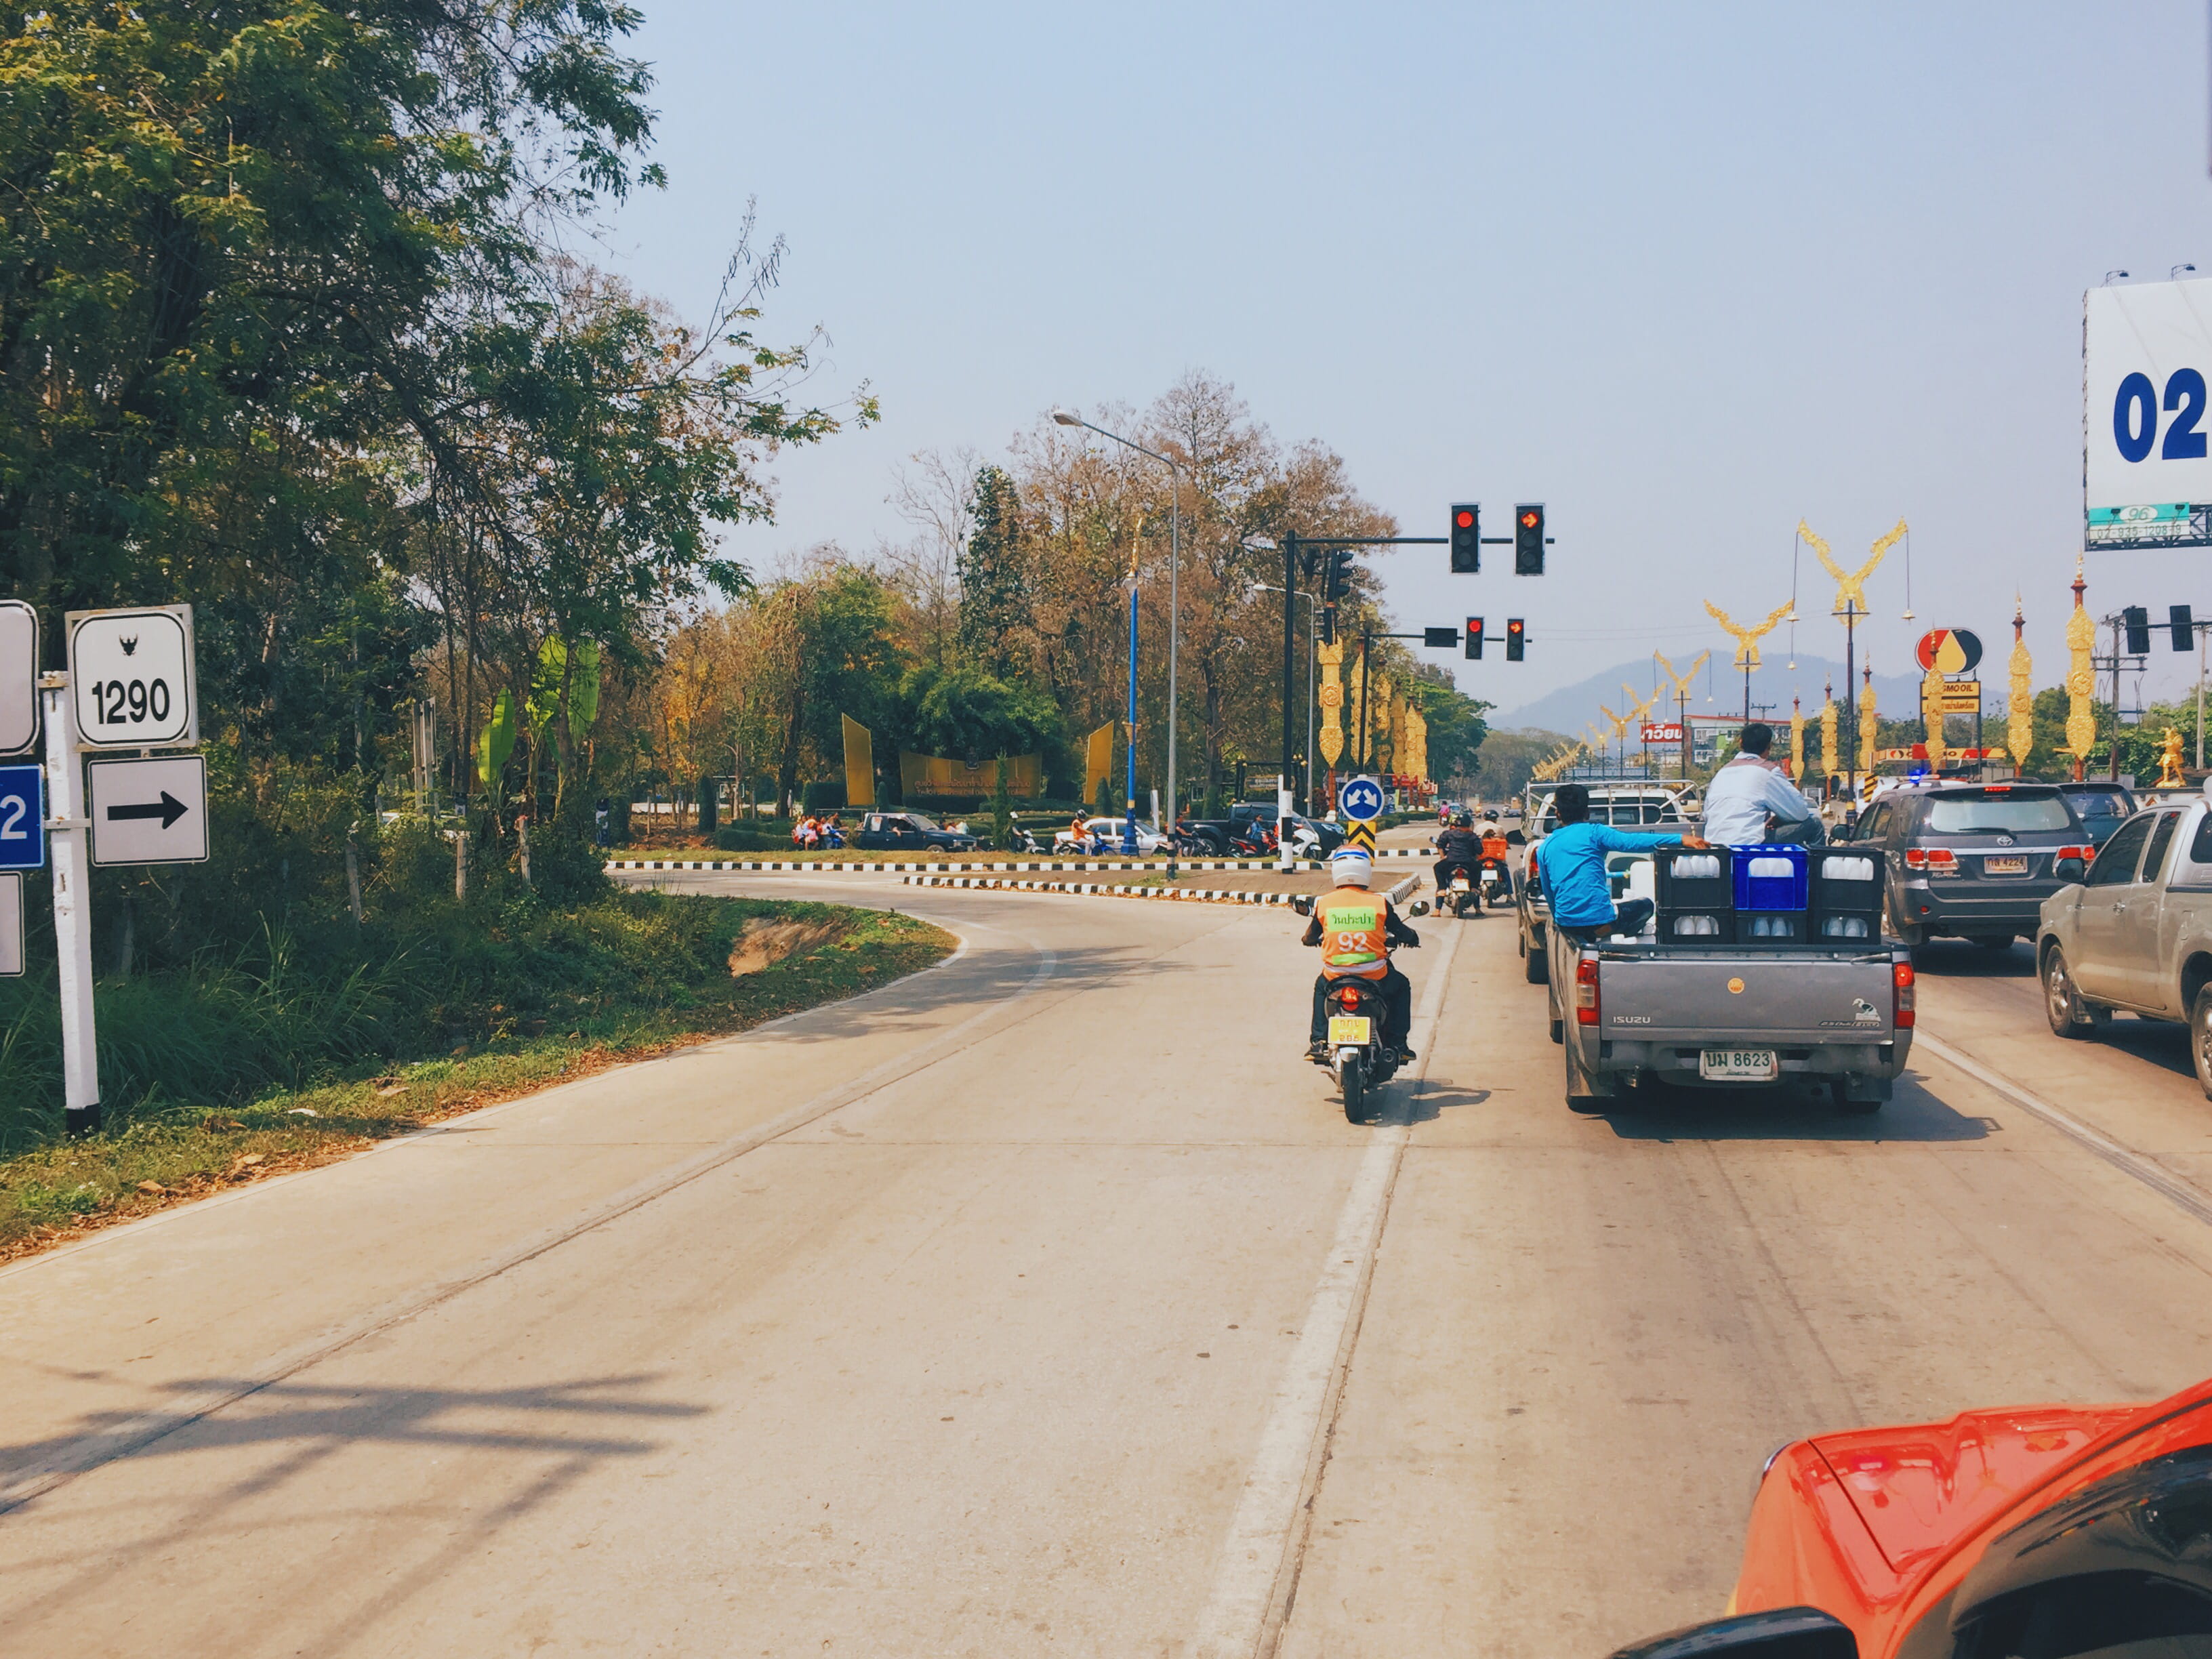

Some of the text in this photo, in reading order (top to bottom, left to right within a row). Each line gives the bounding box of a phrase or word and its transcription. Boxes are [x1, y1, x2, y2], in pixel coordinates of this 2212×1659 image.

[2114, 368, 2207, 463] 02
[2129, 507, 2150, 520] 96
[92, 678, 169, 724] 1290
[1338, 932, 1369, 952] 92
[1734, 1052, 1770, 1067] 8623
